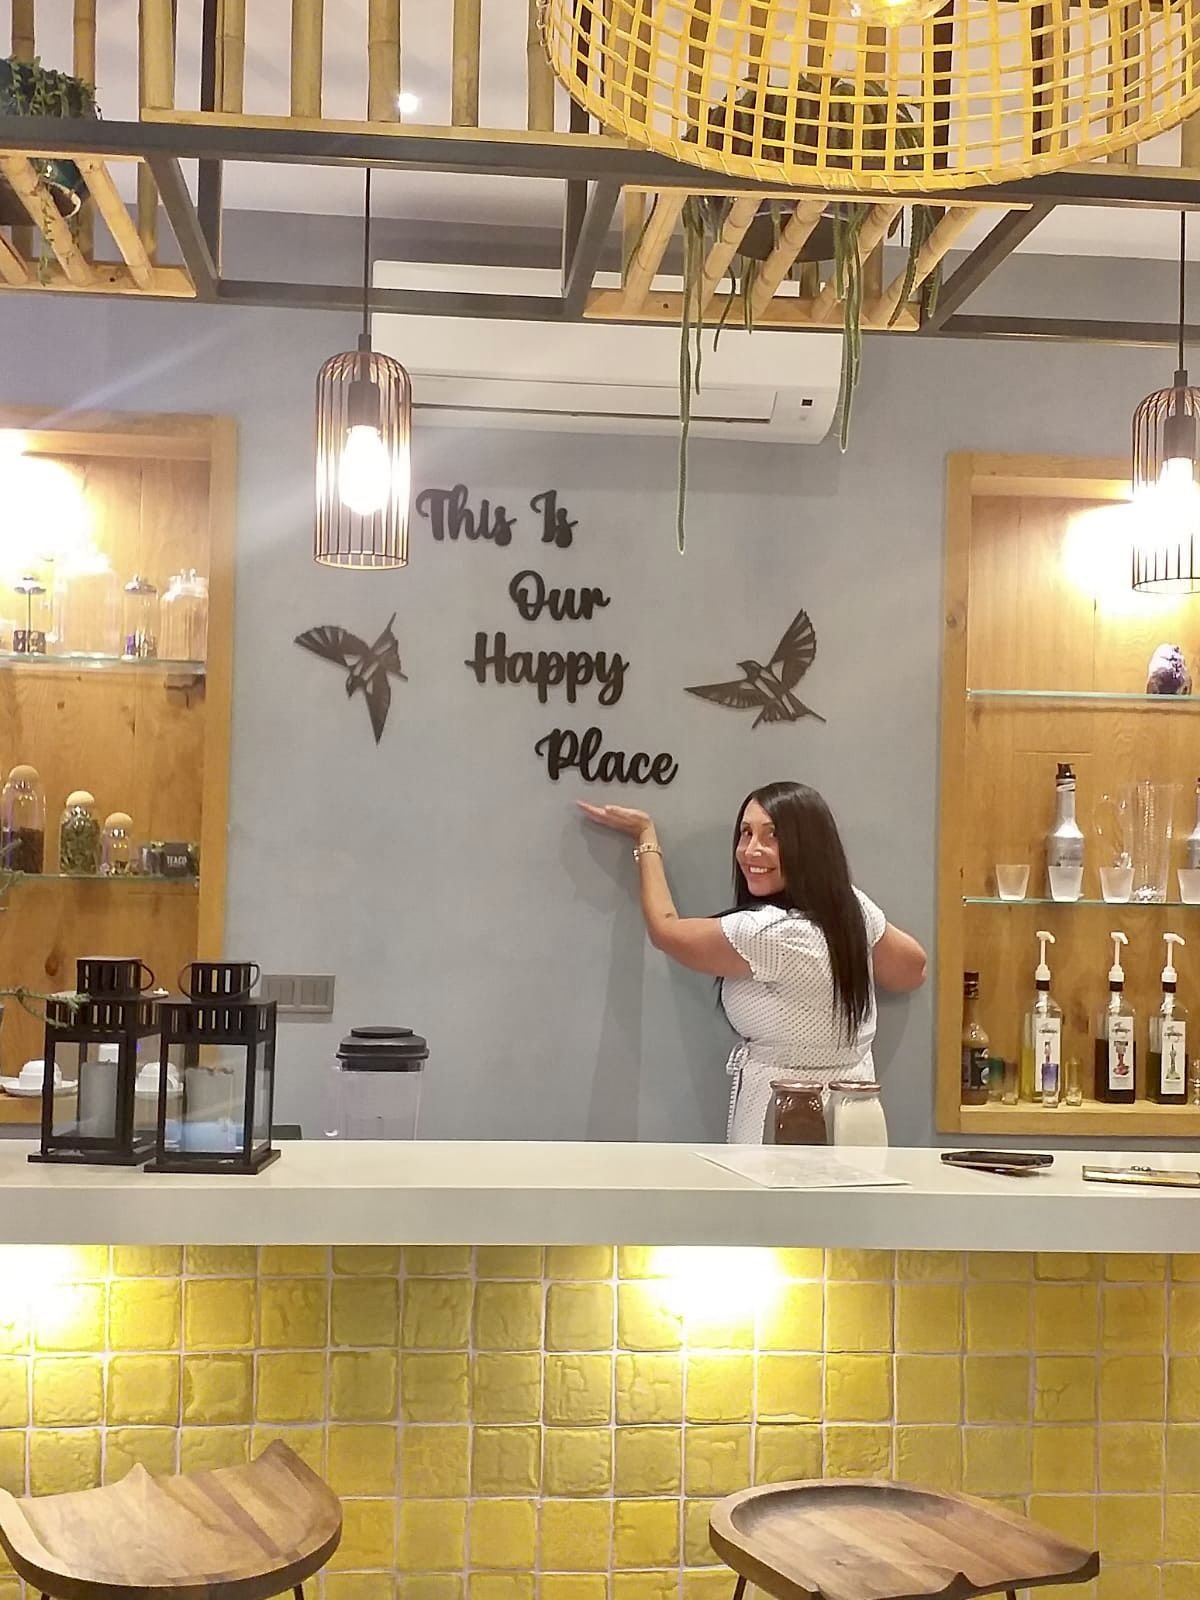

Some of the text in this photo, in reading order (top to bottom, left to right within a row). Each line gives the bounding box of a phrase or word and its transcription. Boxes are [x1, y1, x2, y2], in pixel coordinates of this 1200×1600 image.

[416, 484, 578, 548] This Is
[509, 570, 610, 621] Our
[464, 632, 630, 705] Happy
[534, 727, 679, 785] Place
